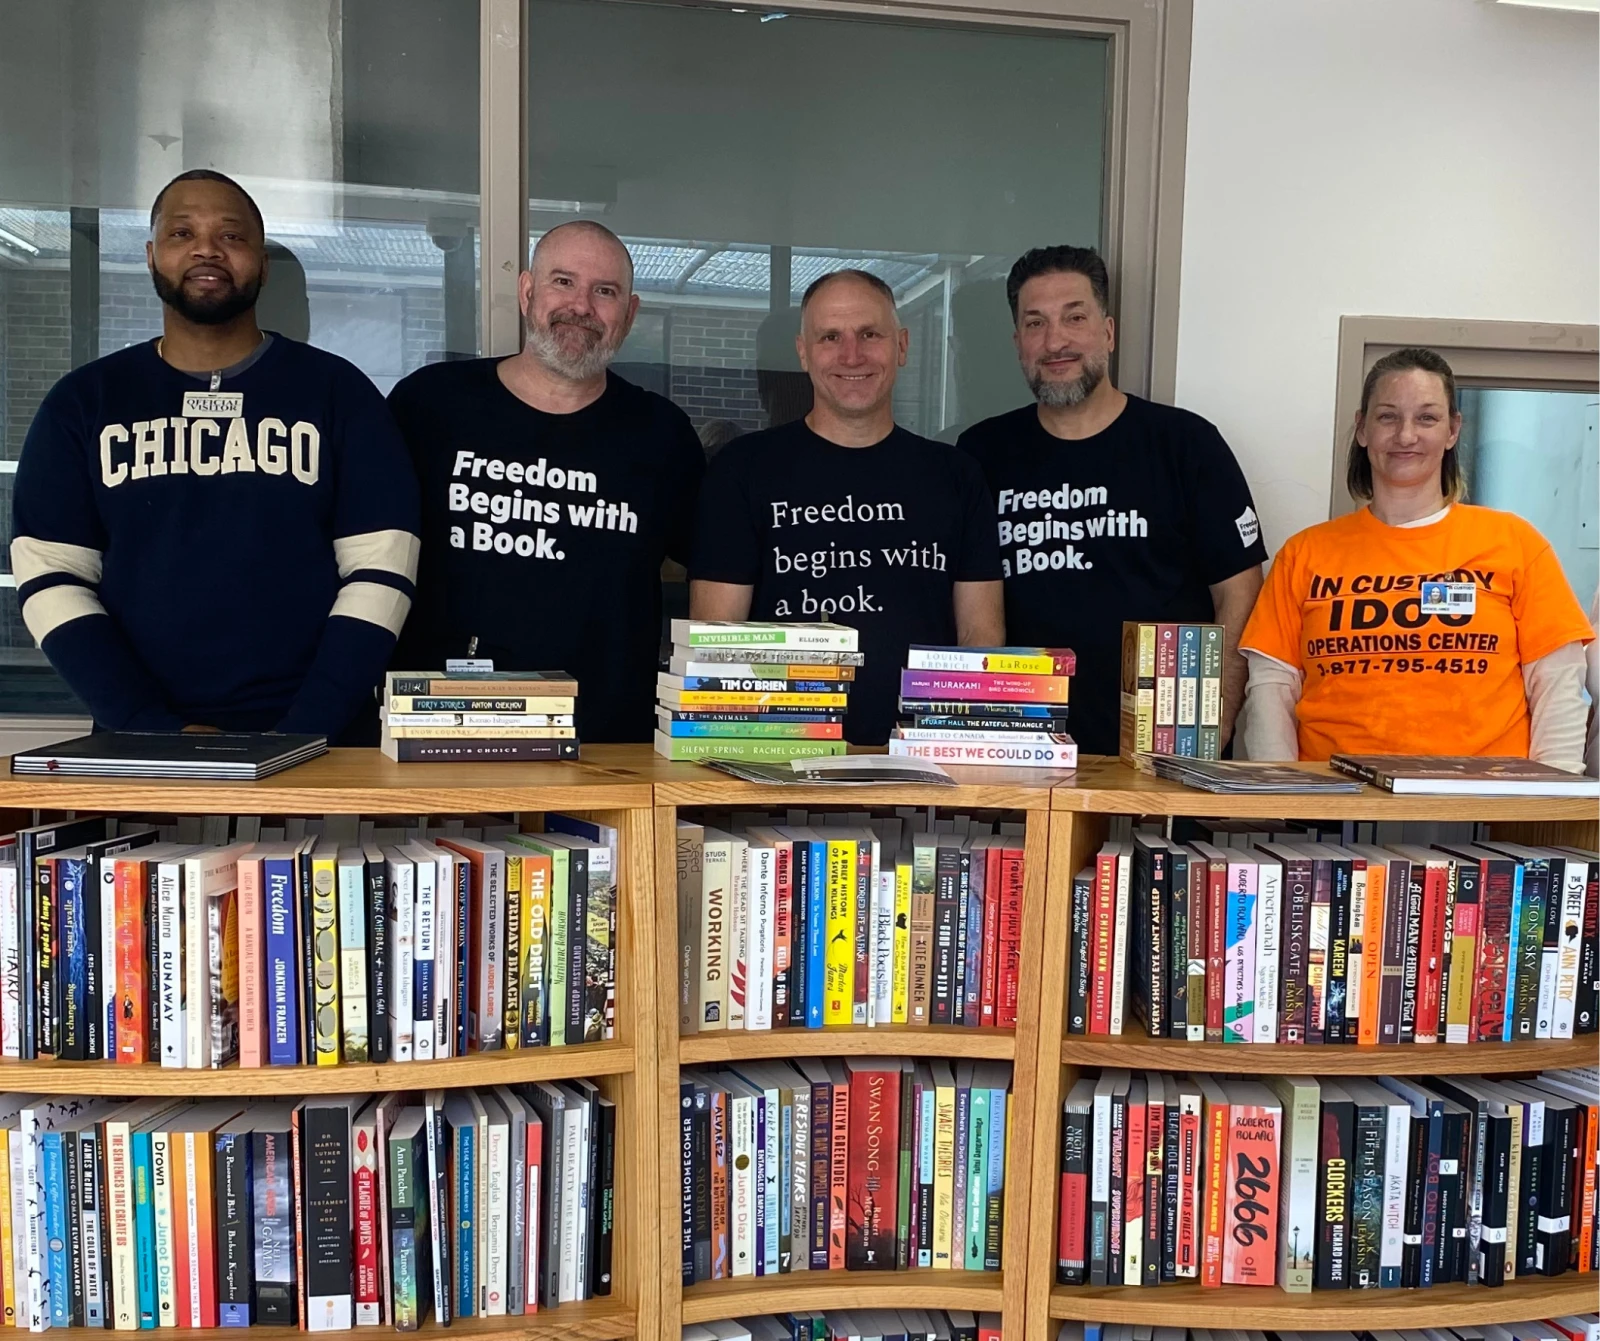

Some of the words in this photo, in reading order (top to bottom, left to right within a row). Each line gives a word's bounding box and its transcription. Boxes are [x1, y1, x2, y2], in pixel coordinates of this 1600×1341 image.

[100, 417, 320, 488] CHICAGO
[452, 450, 596, 493] Freedom
[449, 483, 560, 524] Begins
[568, 499, 638, 533] with
[771, 495, 905, 528] Freedom
[998, 483, 1107, 514] Freedom
[450, 526, 465, 548] a
[473, 521, 565, 560] Book.
[998, 513, 1084, 546] Begins
[1086, 509, 1147, 537] with
[773, 541, 871, 578] begins
[881, 540, 946, 571] with
[1016, 545, 1093, 574] Book.
[775, 600, 792, 616] a
[801, 585, 883, 614] book.
[1310, 574, 1343, 598] IN
[698, 635, 750, 643] INVISIBLE
[1308, 633, 1421, 656] OPERATIONS
[1428, 633, 1499, 651] CENTER
[922, 661, 969, 670] ERDRICH
[927, 653, 965, 661] LOUISE
[1000, 660, 1040, 670] LaRose
[720, 680, 740, 691] TIM
[743, 681, 787, 691] O'BRIEN
[933, 681, 980, 690] MURAKAMI
[417, 701, 437, 709] FORTY
[714, 746, 744, 754] SPRING
[790, 747, 824, 755] CARSON
[906, 746, 930, 756] THE
[934, 747, 962, 757] BEST
[965, 748, 984, 758] WE
[987, 749, 1031, 759] COULD
[1035, 750, 1054, 760] DO
[779, 849, 788, 885] CROOKED
[832, 848, 839, 857] OF
[161, 876, 174, 901] Alice
[422, 886, 431, 905] THE
[488, 879, 497, 920] SELECTED
[531, 869, 544, 899] THE
[1100, 861, 1110, 908] INTERIOR
[270, 874, 288, 935] Freedom
[777, 888, 787, 937] HALLELUJAH
[830, 888, 838, 920] KILLINGS
[840, 884, 848, 918] HISTORY
[1263, 875, 1278, 957] Americanah
[1291, 883, 1304, 940] OBELISK
[1526, 895, 1540, 940] STONE
[1566, 884, 1584, 918] STREET
[161, 906, 174, 938] Munro
[421, 911, 430, 951] RETURN
[488, 921, 496, 951] WORKS
[508, 894, 519, 954] FRIDAY
[530, 904, 544, 939] OLD
[706, 888, 722, 981] WORKING
[488, 952, 495, 962] OF
[776, 946, 787, 968] KELLI
[1098, 913, 1109, 972] CHINATOWN
[1289, 942, 1300, 975] GATE
[1332, 939, 1345, 976] KAREEM
[1525, 945, 1537, 970] SKY
[1562, 946, 1577, 972] ANN
[529, 944, 542, 991] DRIFT
[776, 971, 786, 981] JO
[1366, 942, 1377, 979] OPEN
[162, 951, 173, 1022] RUNAWAY
[274, 958, 287, 1003] JONATHAN
[507, 956, 518, 1009] BLACK
[776, 984, 785, 1005] FORD
[1558, 974, 1573, 1002] PETRY
[276, 1005, 287, 1044] FRANZEN
[834, 1091, 846, 1131] KAITLYN
[868, 1076, 884, 1123] SWAN
[568, 1125, 576, 1150] PAUL
[1168, 1112, 1179, 1139] BLACK
[83, 1142, 93, 1169] JAMES
[225, 1139, 234, 1154] The
[396, 1146, 407, 1165] Ann
[833, 1135, 846, 1188] GREENIDGE
[866, 1125, 882, 1171] SONG
[1168, 1145, 1178, 1169] HOLE
[1364, 1130, 1378, 1166] FIFTH
[154, 1141, 166, 1186] Drown
[226, 1156, 235, 1197] Poisonwood
[567, 1152, 576, 1192] BEATTY
[683, 1118, 692, 1223] LATEHOMECOMER
[757, 1149, 765, 1193] ENTANGLED
[84, 1171, 94, 1204] McBRIDE
[397, 1168, 407, 1204] Patchett
[1167, 1174, 1178, 1204] BLUES
[1233, 1152, 1271, 1247] 2666
[1326, 1158, 1346, 1222] CLOCKERS
[1361, 1169, 1374, 1220] SEASON
[226, 1200, 236, 1219] Bible
[756, 1194, 764, 1228] EMPATHY
[86, 1220, 95, 1233] THE
[157, 1222, 168, 1261] Junot
[683, 1229, 691, 1251] THE
[1332, 1225, 1344, 1256] RICHARD
[87, 1236, 96, 1259] COLOR
[262, 1226, 274, 1279] GAIMAN
[273, 1241, 281, 1263] NEIL
[88, 1261, 96, 1271] OF
[160, 1265, 170, 1295] Díaz
[1331, 1258, 1342, 1281] PRICE
[89, 1273, 97, 1297] WATER
